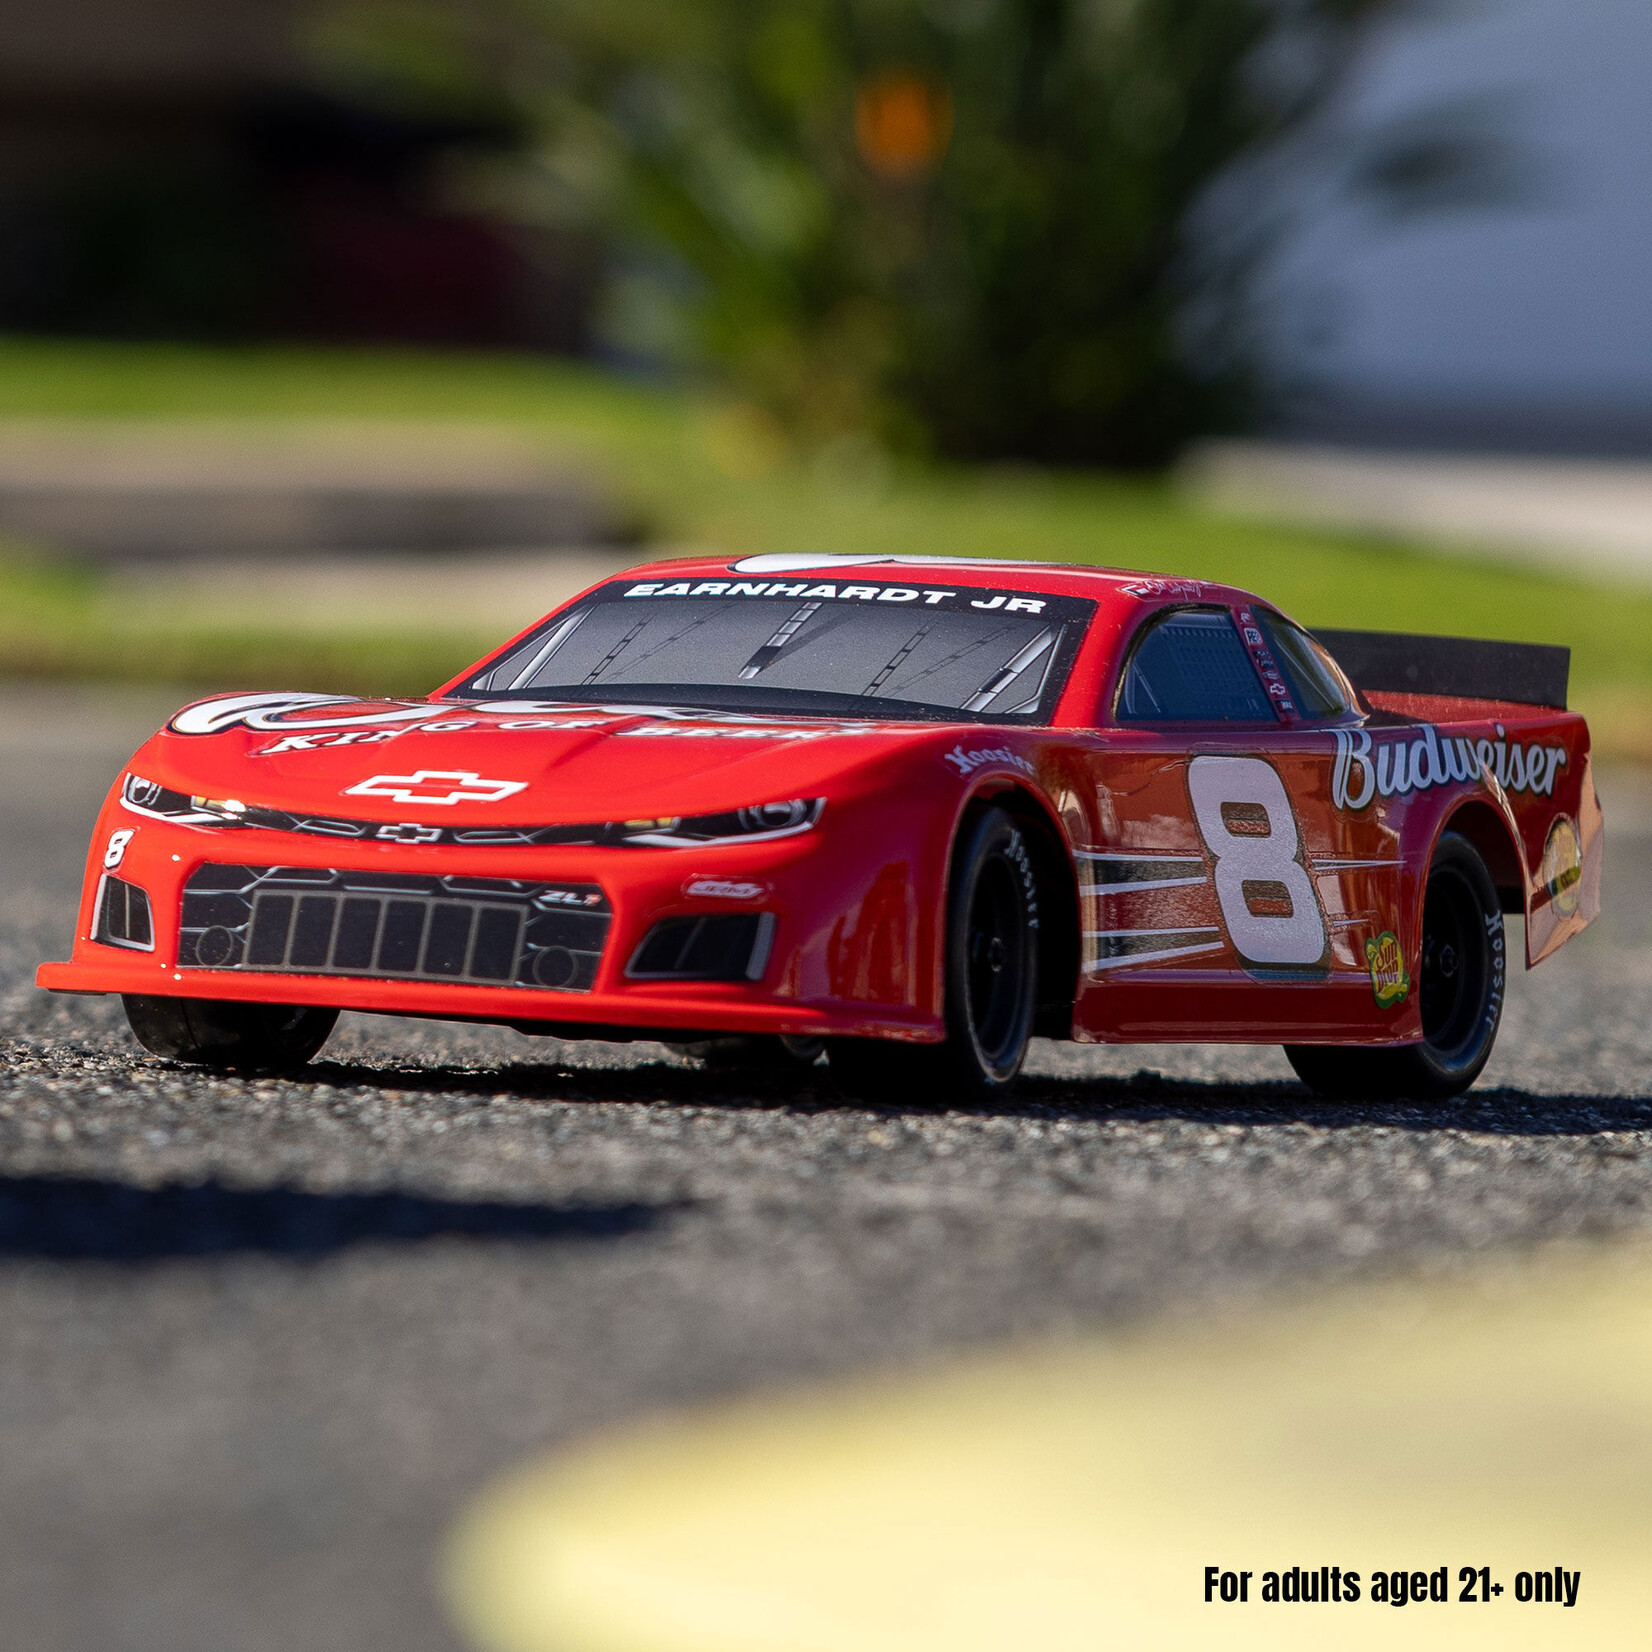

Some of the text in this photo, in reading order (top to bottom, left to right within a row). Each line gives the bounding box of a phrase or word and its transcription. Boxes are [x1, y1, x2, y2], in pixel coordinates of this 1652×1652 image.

[623, 582, 1048, 614] EARNHARDT JR
[258, 721, 477, 755] KING
[498, 720, 608, 730] OF
[945, 745, 1035, 775] Hoosier
[1327, 723, 1567, 810] Budweiser
[104, 829, 135, 869] 8
[1187, 755, 1327, 967] 8
[538, 889, 603, 907] ZL1
[1375, 940, 1398, 970] Sun
[1484, 909, 1504, 1032] Hoosier
[1375, 961, 1400, 994] Drop
